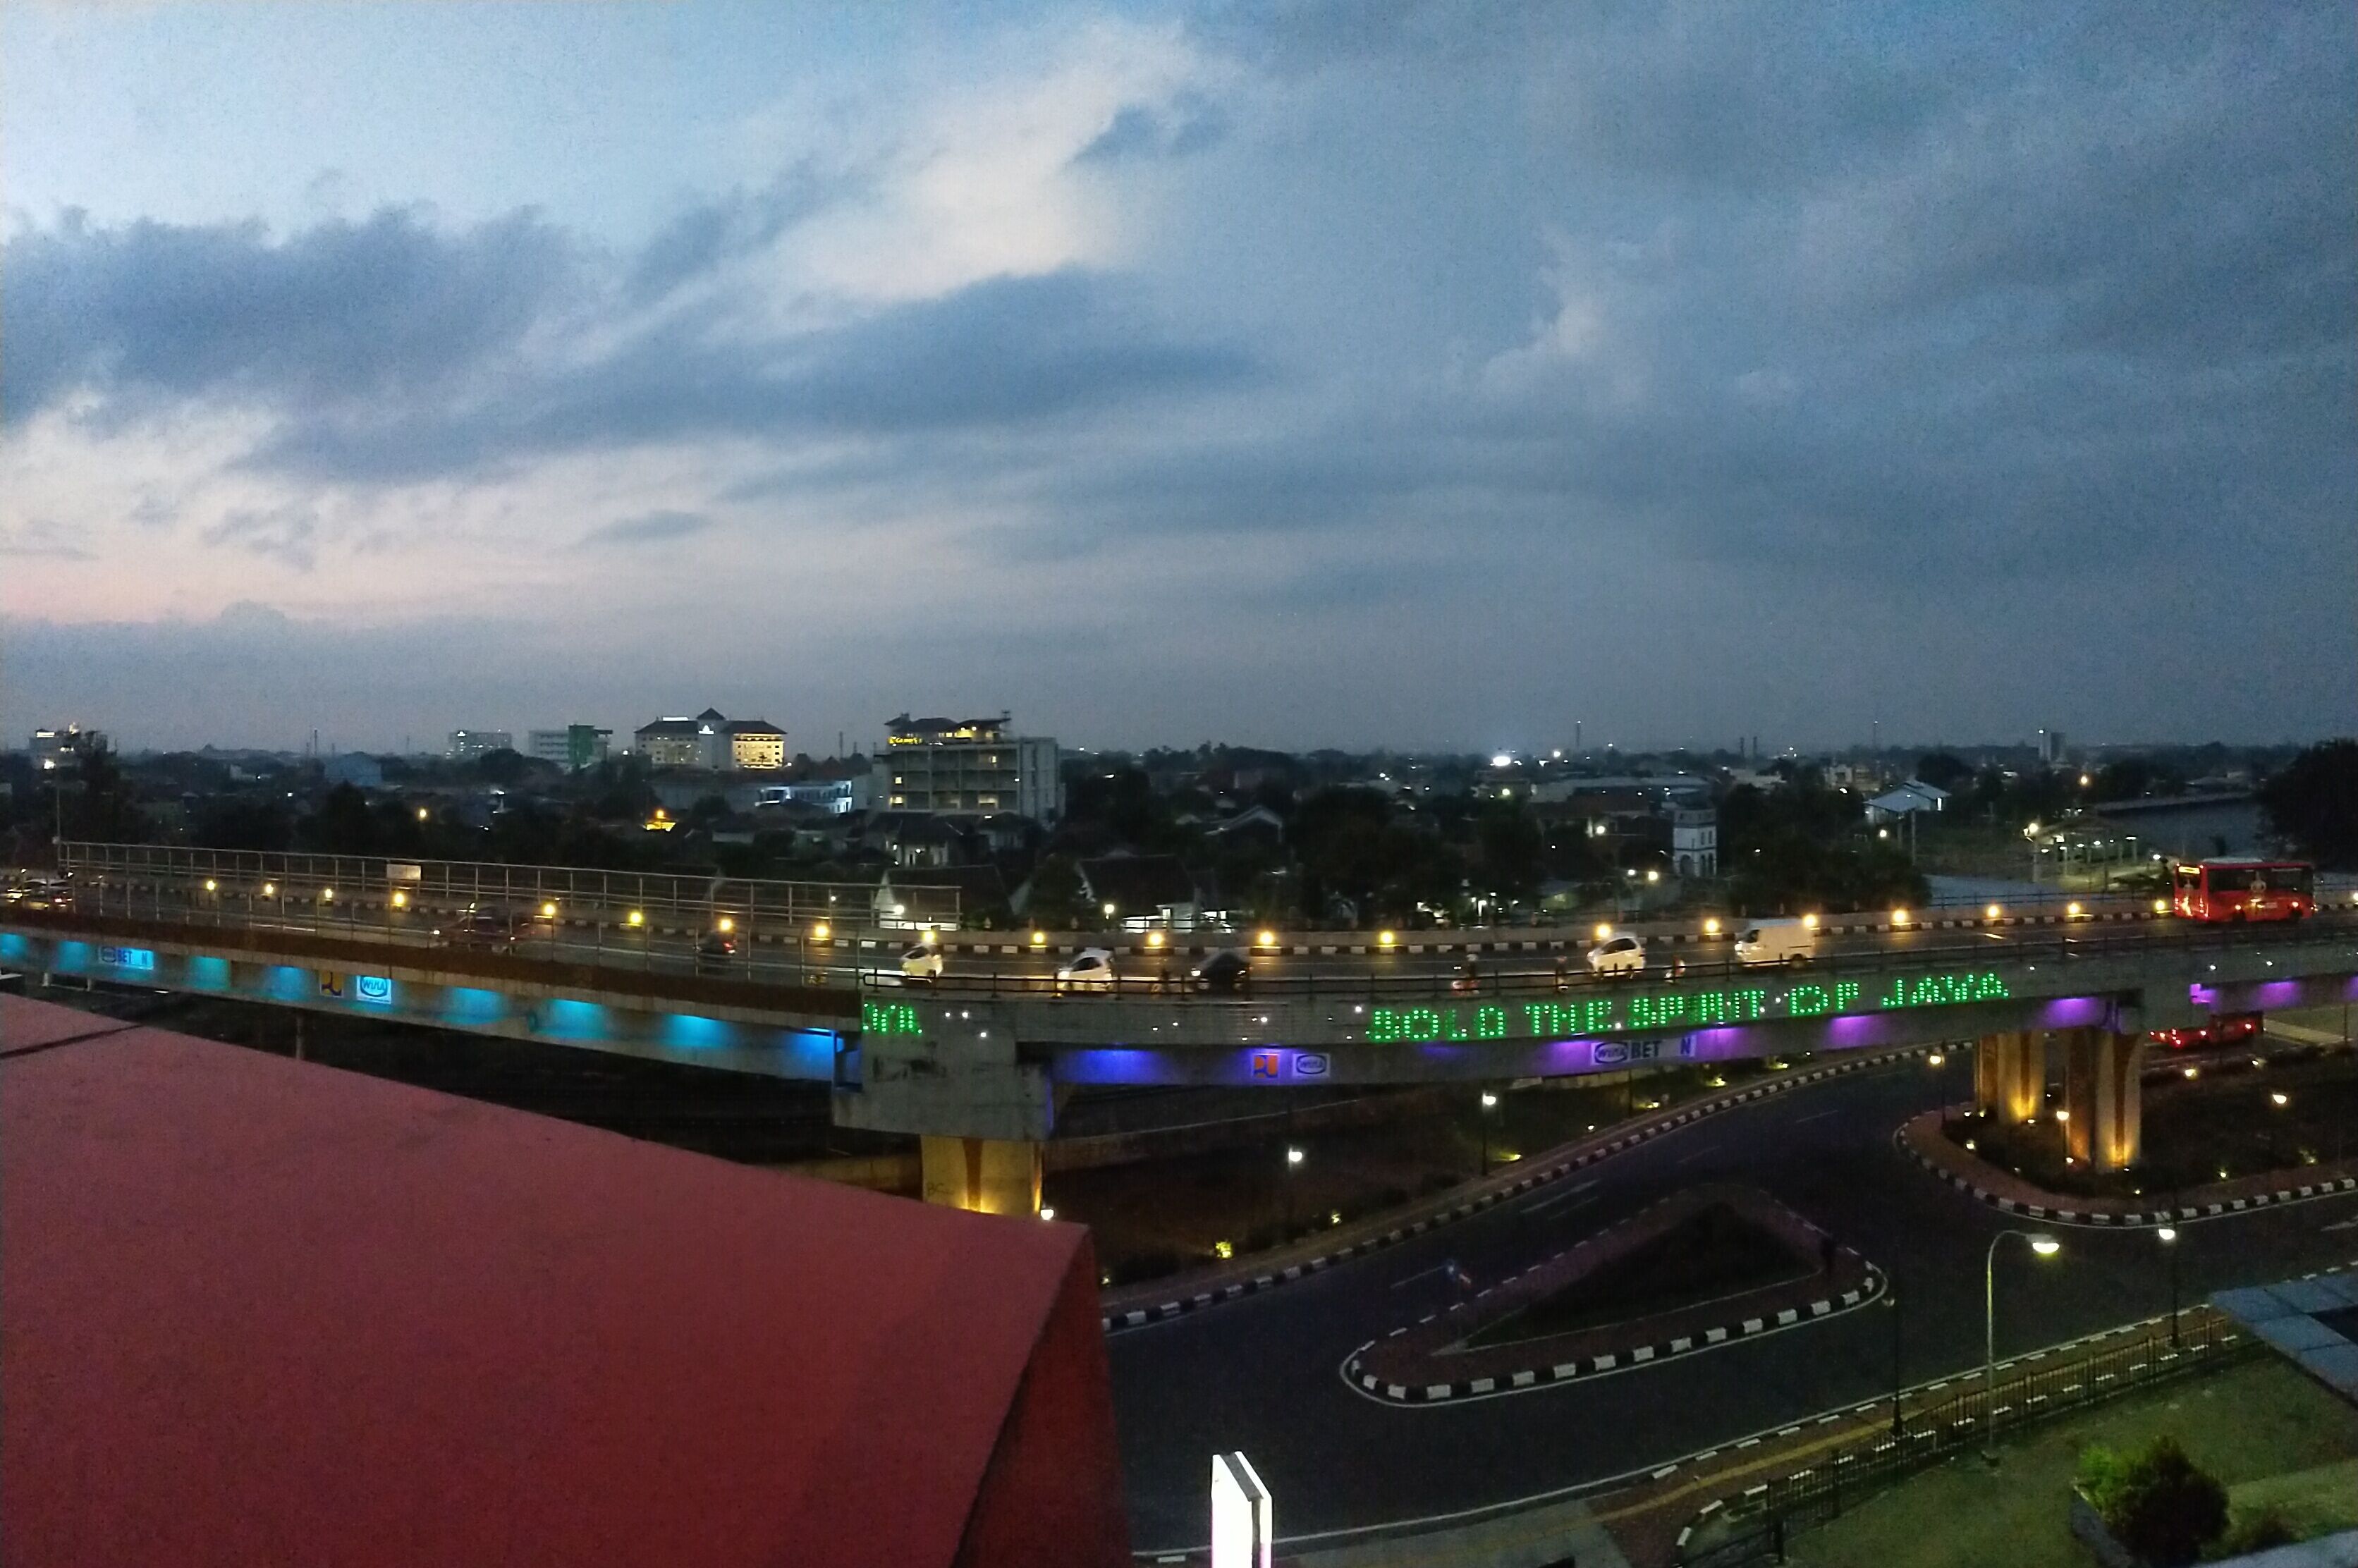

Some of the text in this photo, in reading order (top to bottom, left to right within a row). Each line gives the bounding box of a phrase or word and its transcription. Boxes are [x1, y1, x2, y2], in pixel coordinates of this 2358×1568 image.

[1365, 1007, 1505, 1040] SOLO
[1524, 1000, 1613, 1034] THE
[1789, 981, 1859, 1014] OF
